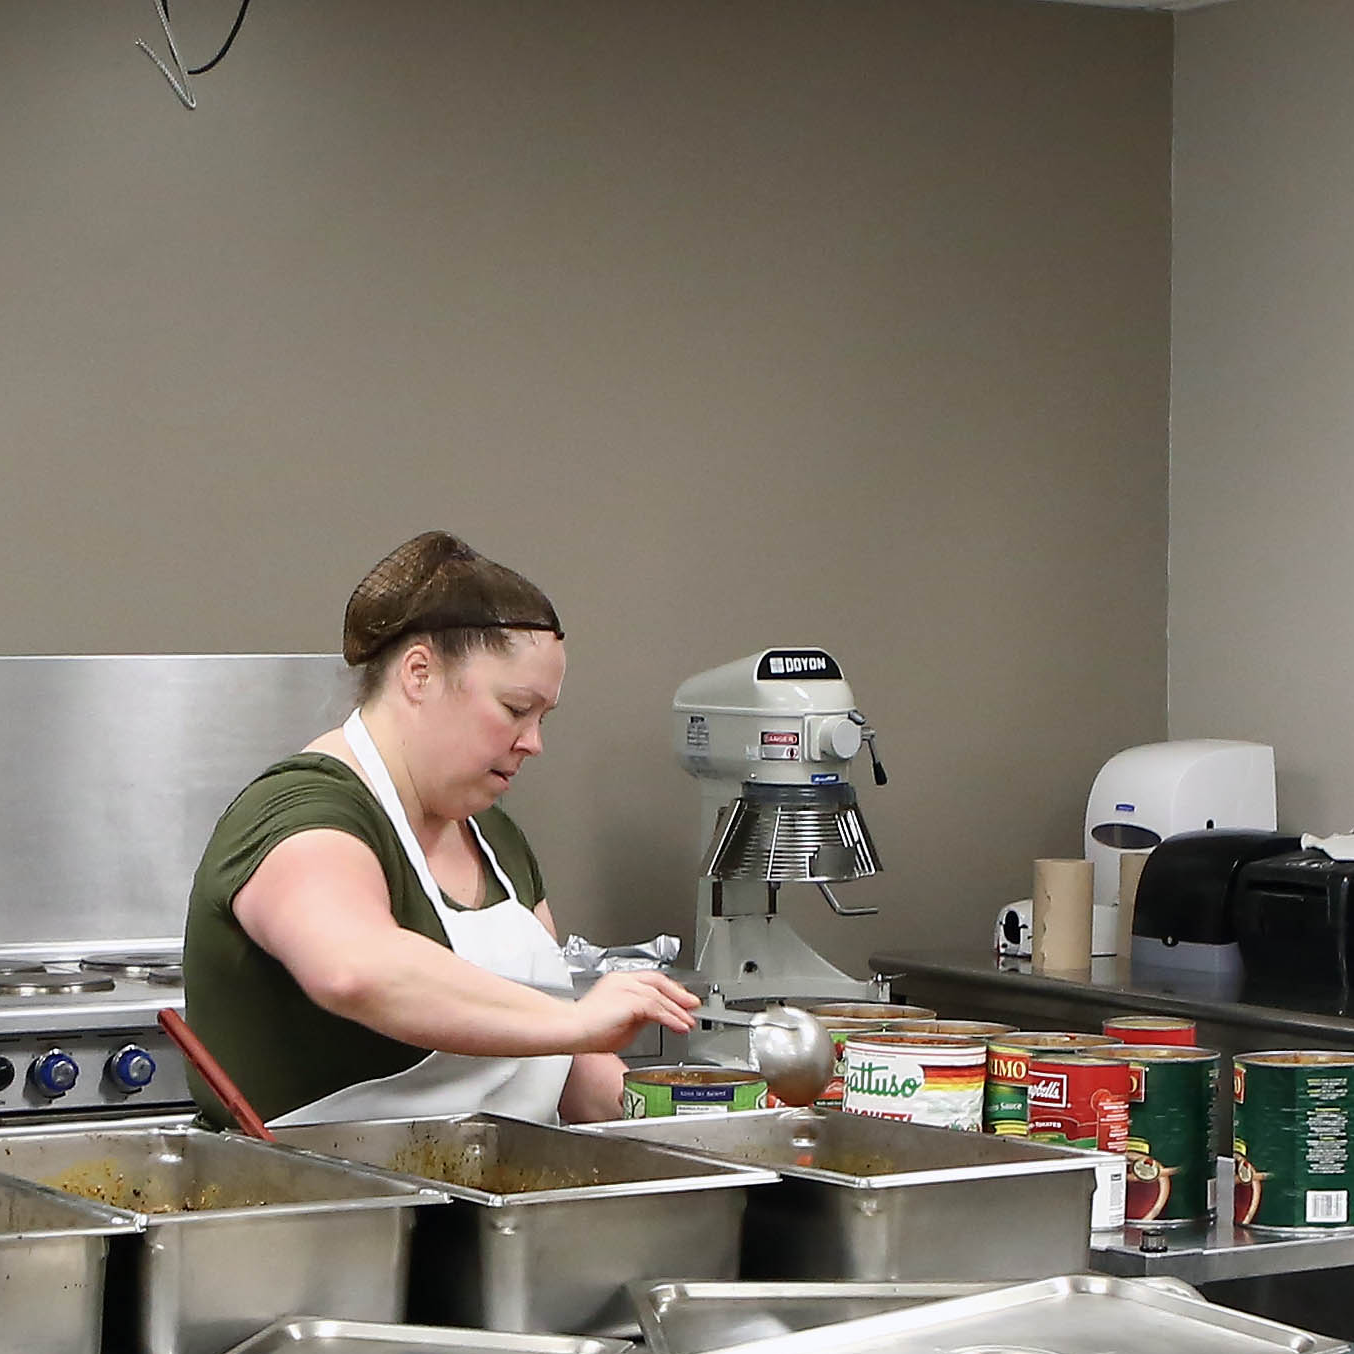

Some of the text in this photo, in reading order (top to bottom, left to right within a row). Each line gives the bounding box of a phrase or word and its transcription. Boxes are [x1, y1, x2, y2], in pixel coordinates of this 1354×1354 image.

[785, 657, 827, 673] DOYON
[845, 1061, 922, 1098] attuso
[988, 1058, 1027, 1080] RIMO
[1028, 1079, 1061, 1100] pbell's
